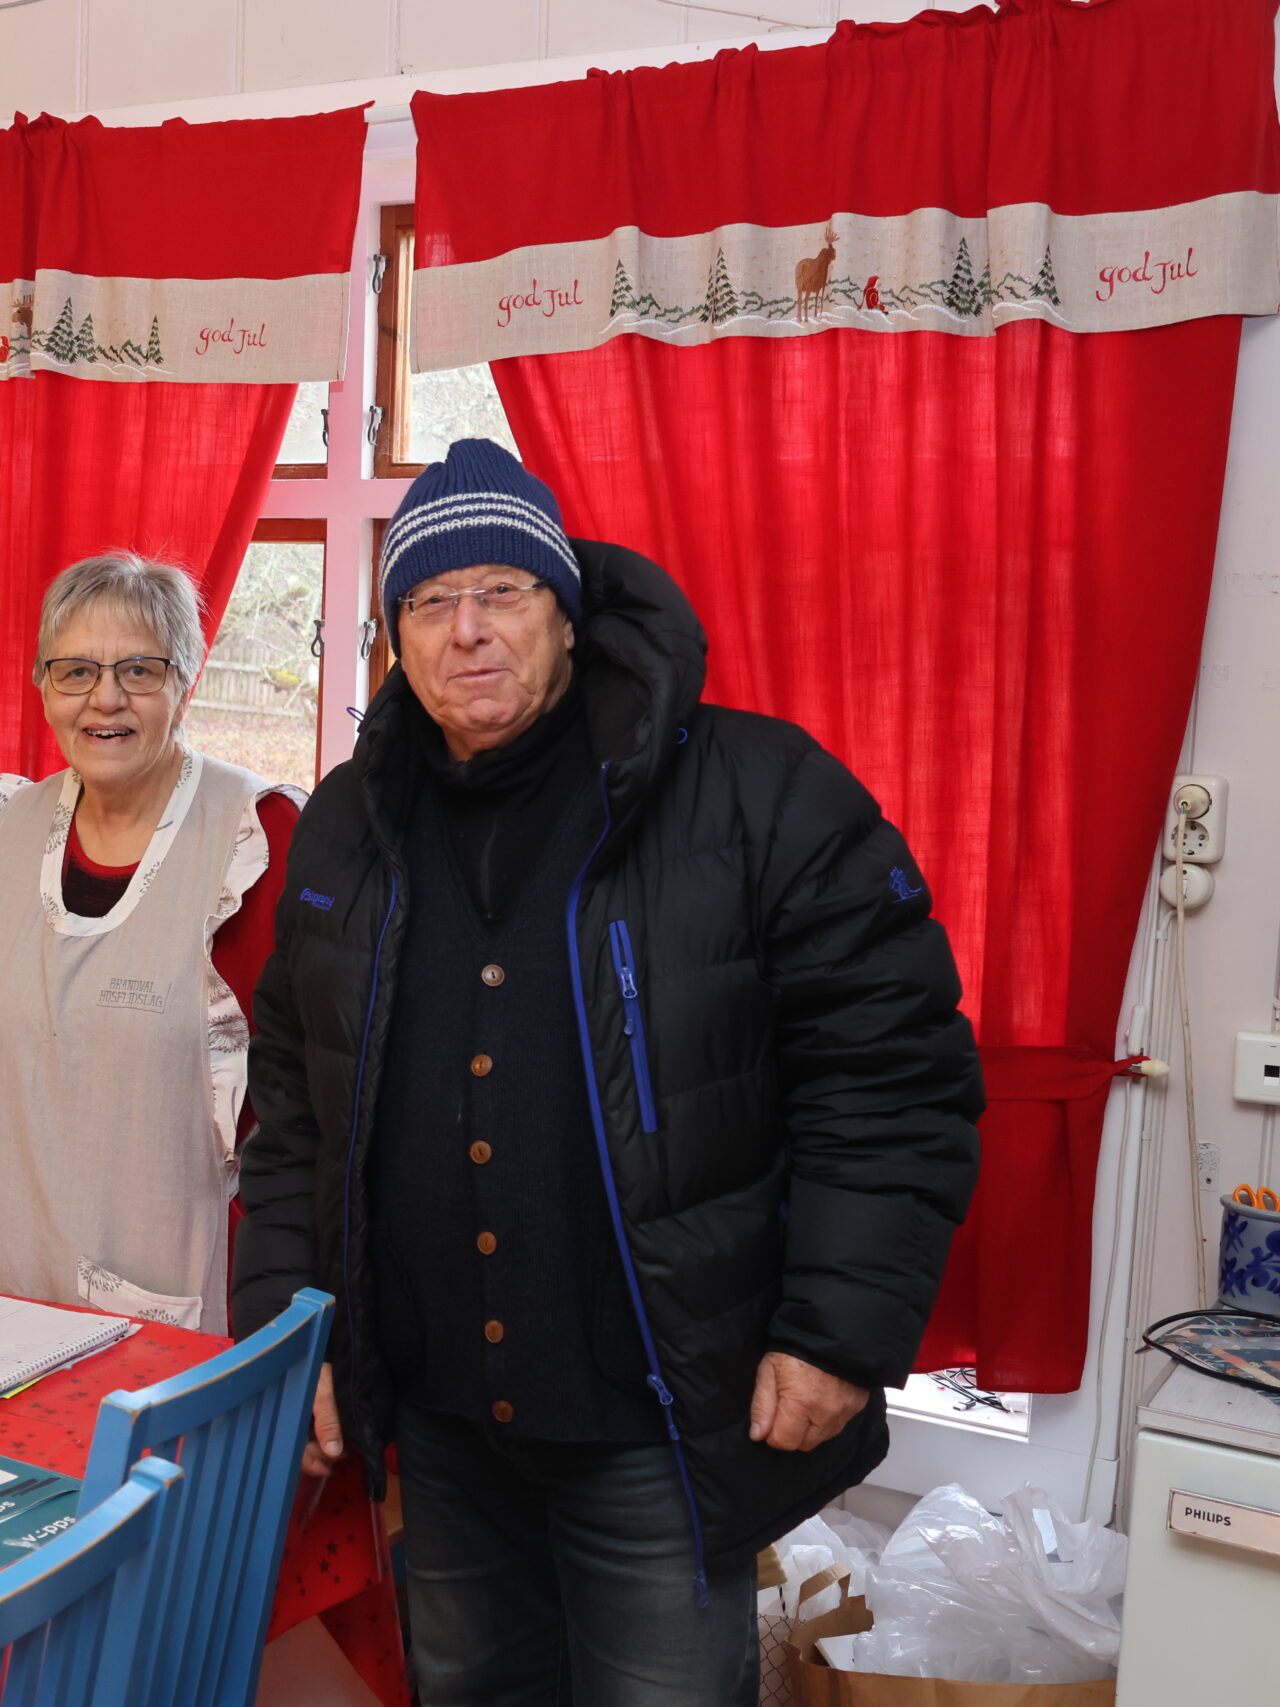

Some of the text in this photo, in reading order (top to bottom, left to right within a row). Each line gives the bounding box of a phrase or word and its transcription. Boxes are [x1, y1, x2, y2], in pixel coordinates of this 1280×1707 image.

[1095, 250, 1154, 302] god
[497, 278, 542, 327] god
[195, 317, 235, 355] god
[1185, 1507, 1232, 1526] PHILIPS
